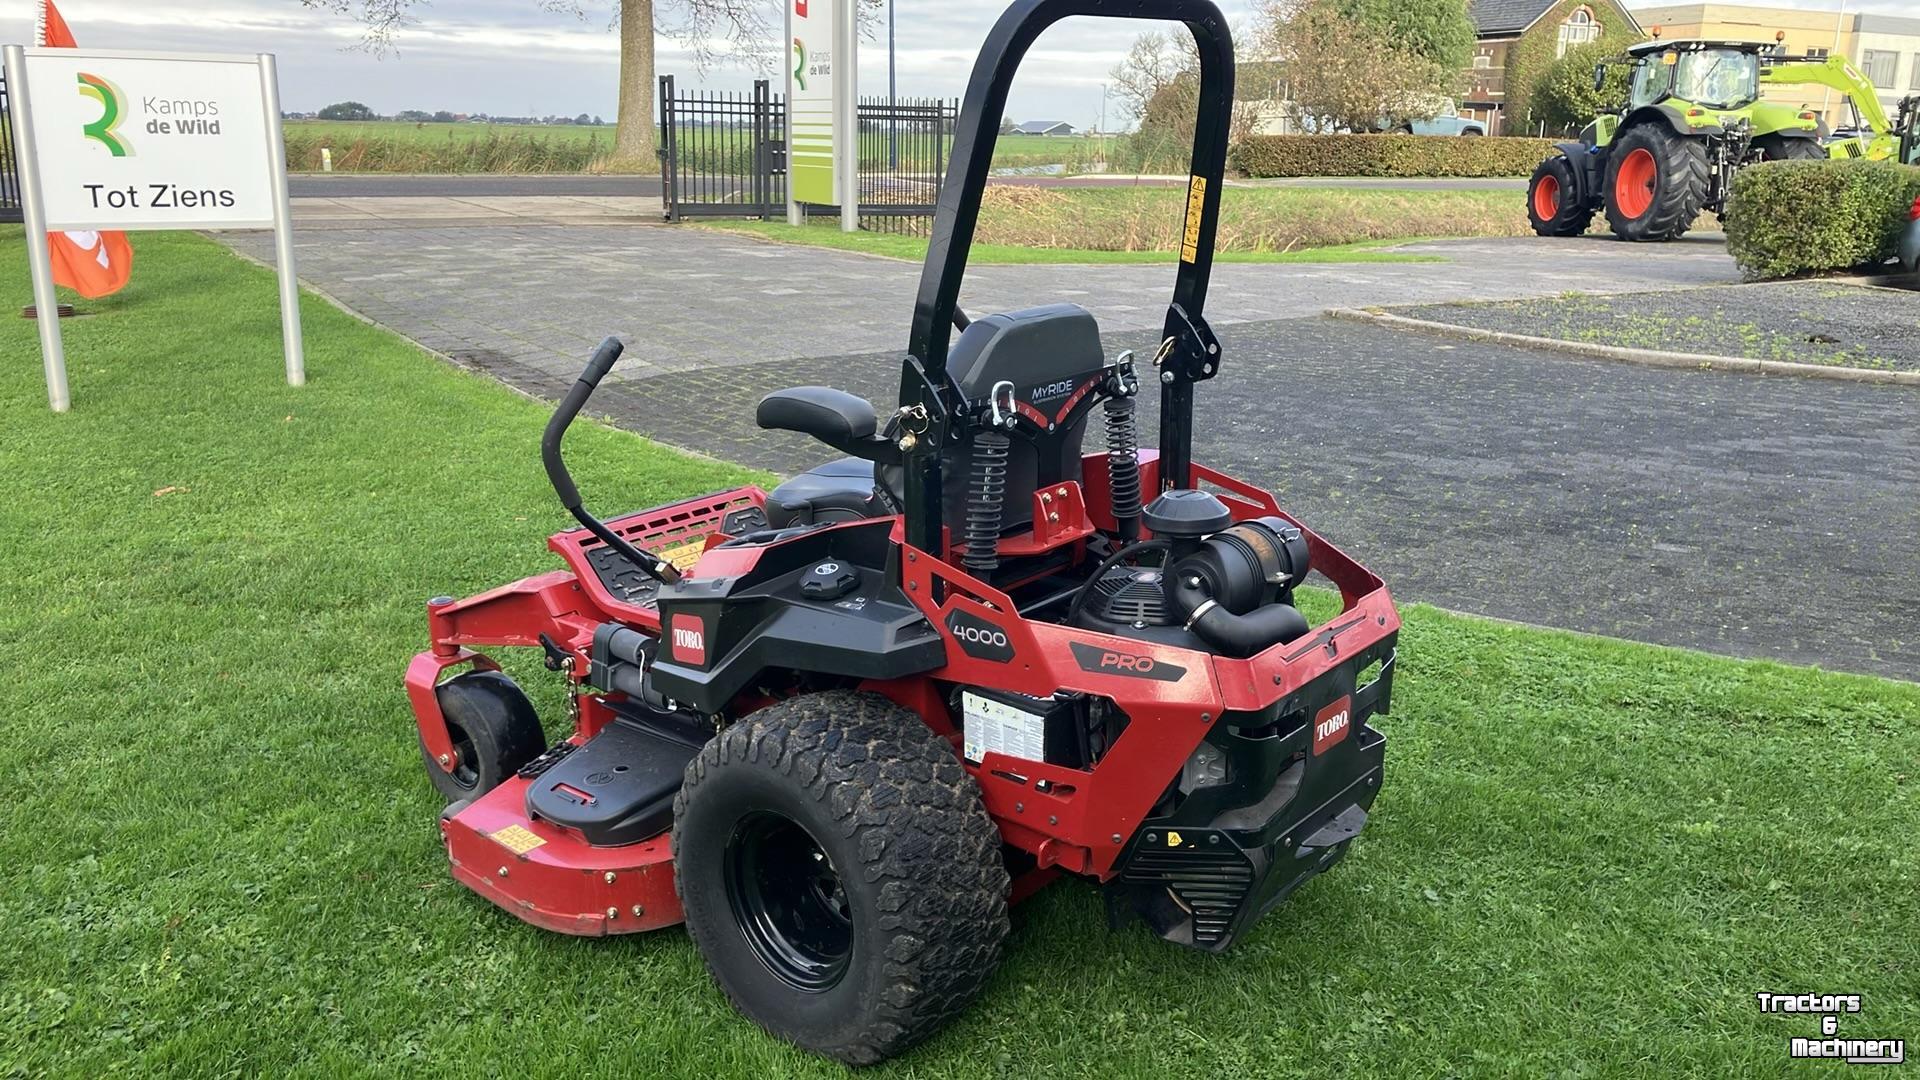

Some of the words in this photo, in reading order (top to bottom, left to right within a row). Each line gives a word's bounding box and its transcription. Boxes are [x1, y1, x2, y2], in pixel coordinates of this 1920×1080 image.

[143, 96, 219, 118] Kamps
[146, 118, 170, 134] de
[174, 119, 221, 135] Wild
[83, 184, 139, 209] Tot
[149, 184, 236, 208] Ziens
[953, 624, 1007, 648] 4000
[1100, 652, 1155, 673] PRO
